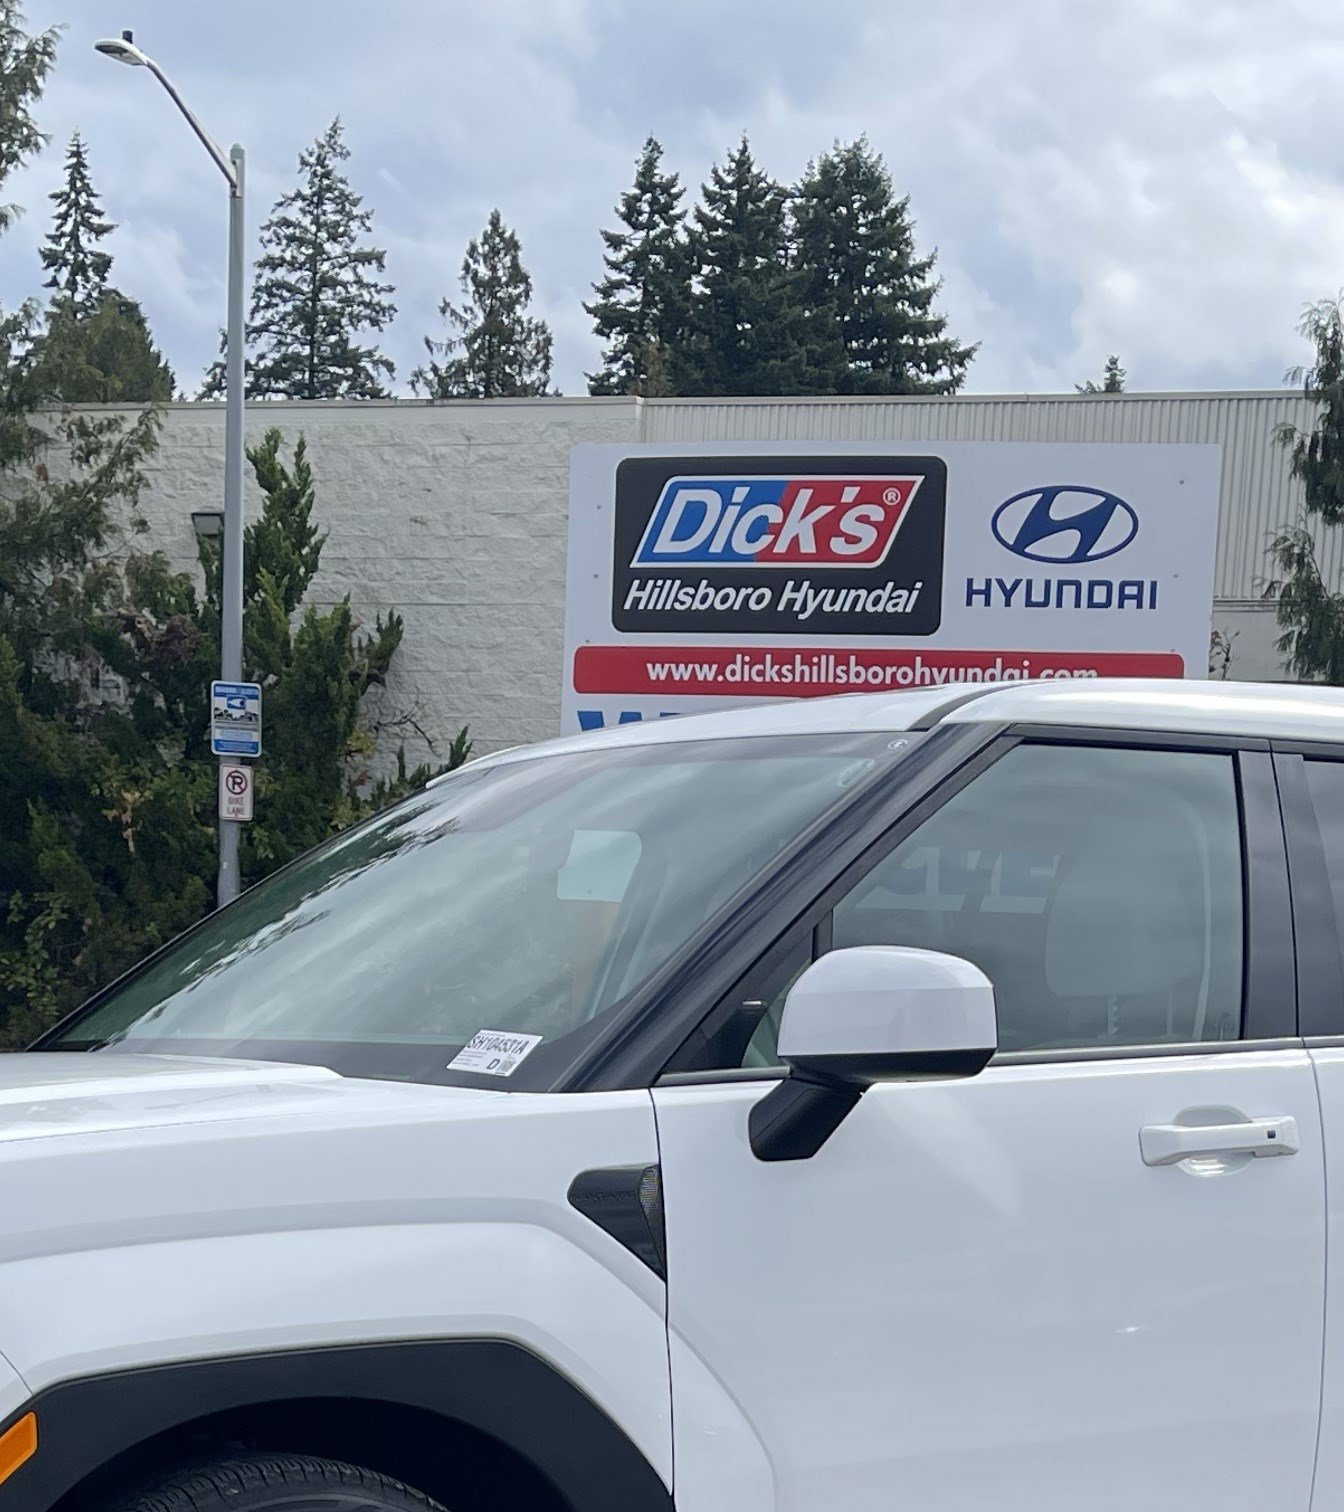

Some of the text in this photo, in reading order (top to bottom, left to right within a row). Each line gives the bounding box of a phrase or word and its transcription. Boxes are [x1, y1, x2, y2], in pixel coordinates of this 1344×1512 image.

[653, 486, 885, 555] Dick's
[623, 580, 923, 620] Hillsboro Hyundai
[965, 577, 1158, 610] HYUNDAI
[646, 654, 1098, 687] www.dickshillsborohyundaicom
[487, 1059, 501, 1070] D
